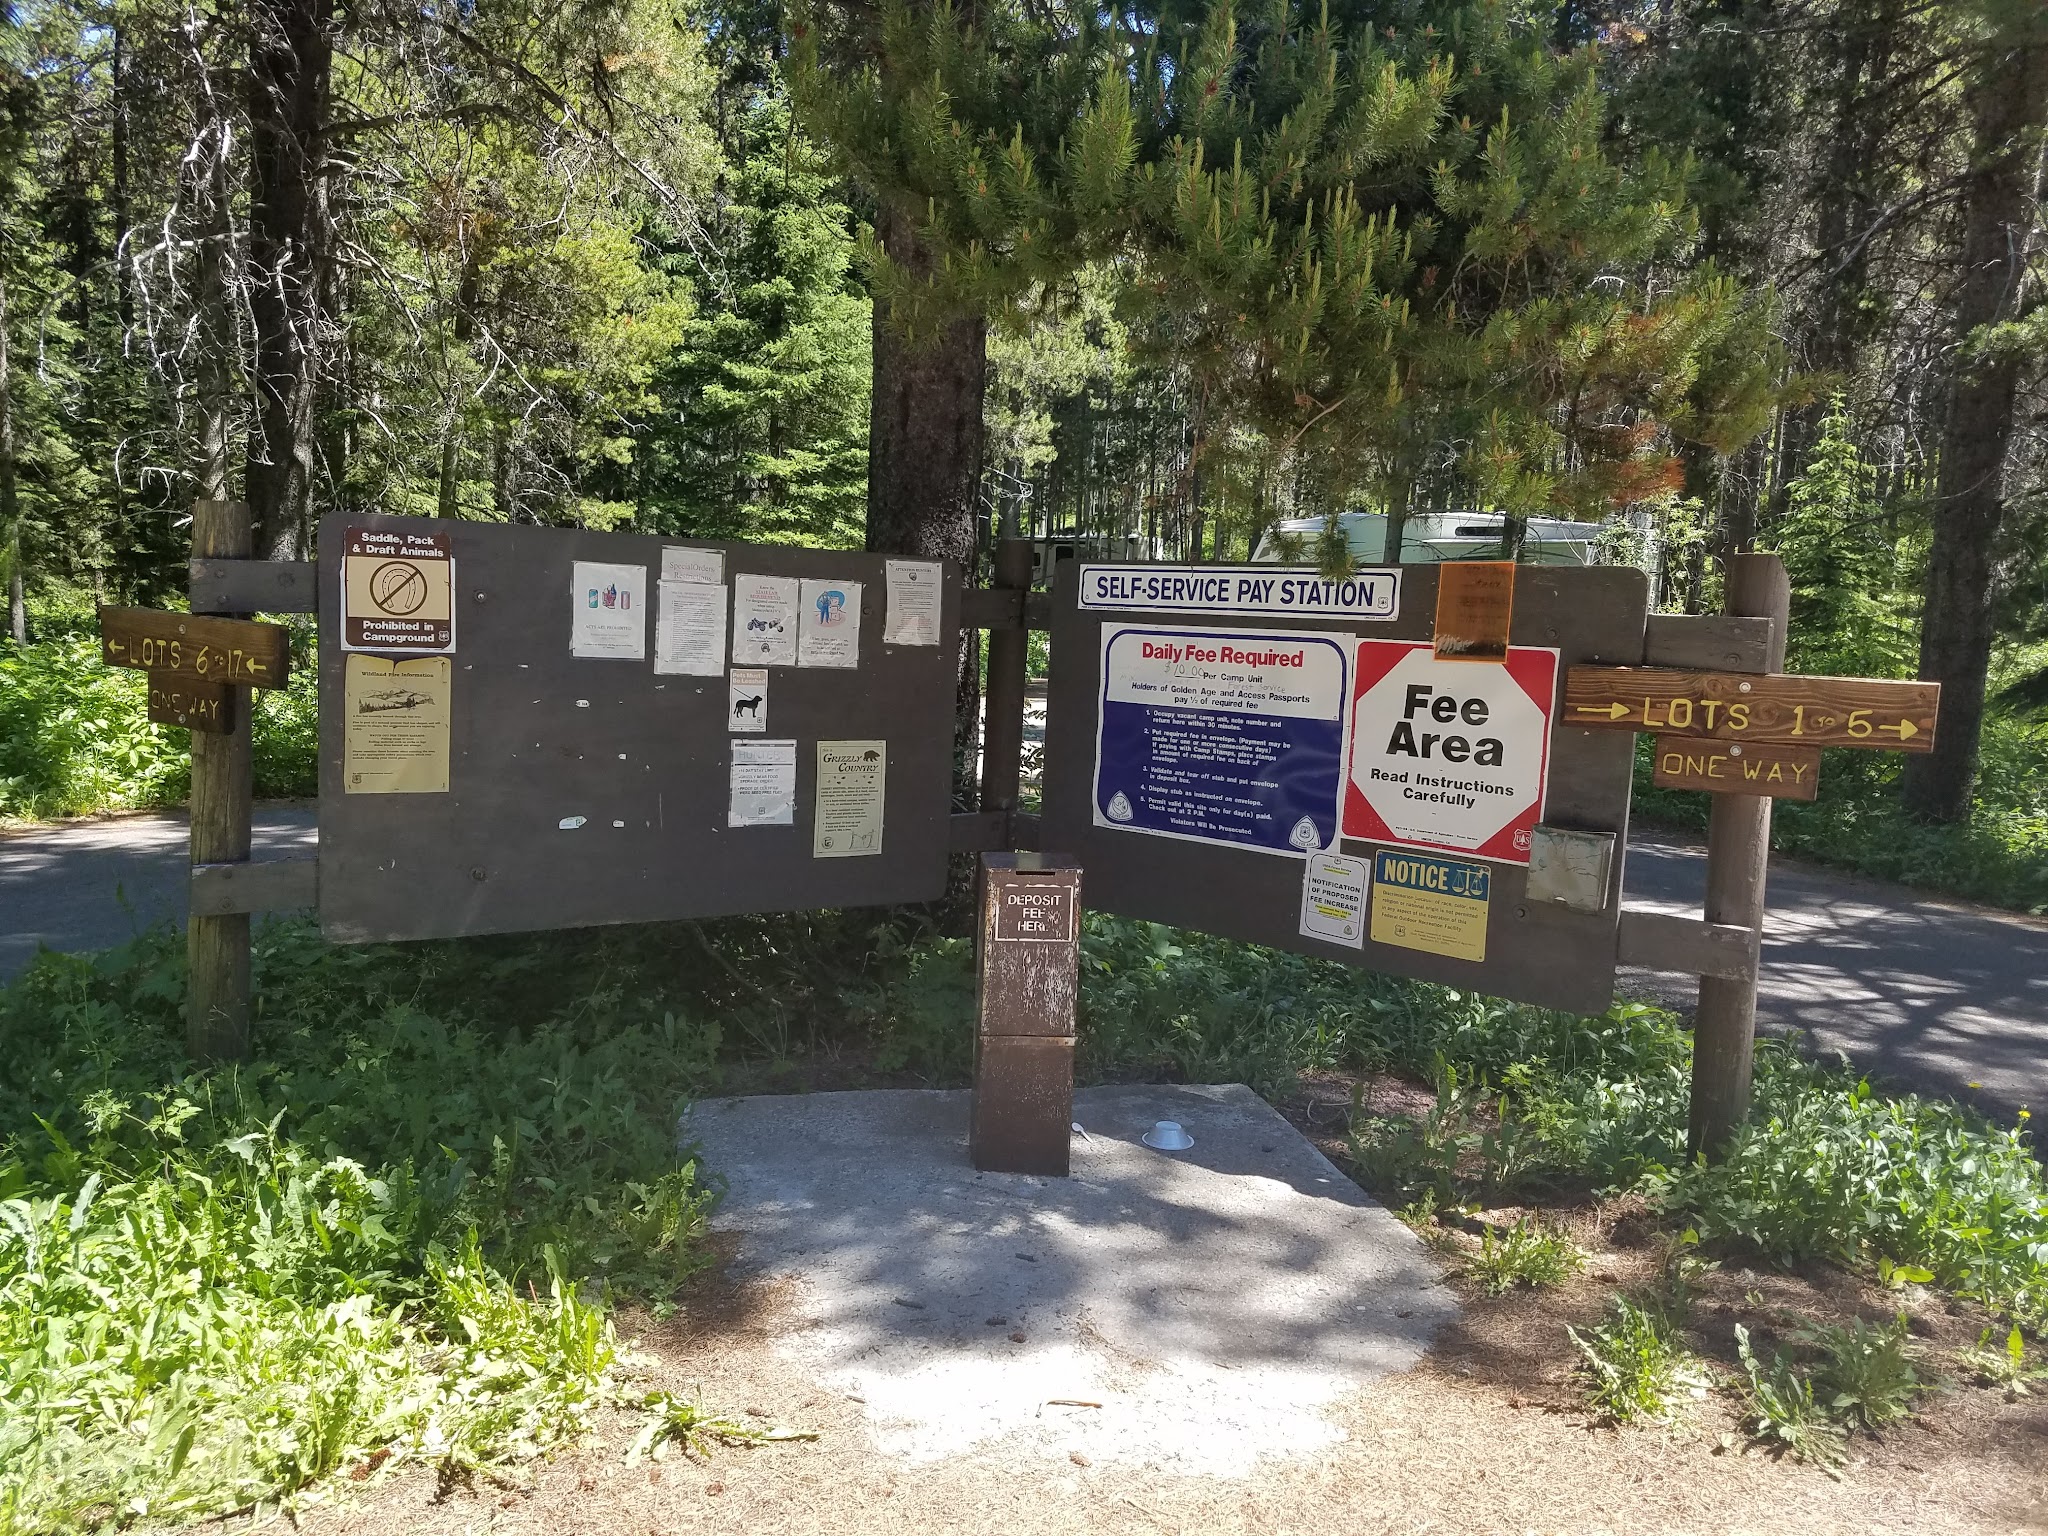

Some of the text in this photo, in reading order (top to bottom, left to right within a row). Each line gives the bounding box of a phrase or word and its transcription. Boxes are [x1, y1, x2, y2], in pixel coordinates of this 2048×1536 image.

[361, 532, 434, 545] Saddle, Pack
[352, 544, 444, 557] & Draft Animals
[1097, 576, 1374, 607] SELF-SERVICE PAY STATION
[363, 621, 434, 631] Prohibited in
[362, 632, 434, 643] Campground
[129, 636, 181, 669] LOTS
[196, 645, 209, 674] 6
[228, 649, 243, 678] 17
[1142, 642, 1304, 668] Daily Fee Required
[1203, 672, 1263, 683] Per Camp Unit
[1132, 682, 1157, 691] Holders
[1171, 686, 1197, 694] Golden
[1201, 688, 1216, 696] Age
[1238, 691, 1266, 700] Access
[1269, 693, 1310, 704] Passports
[151, 690, 219, 721] ONE WAY
[1174, 697, 1188, 705] pay
[1211, 699, 1243, 708] required
[1246, 701, 1258, 709] fee
[1404, 684, 1489, 726] Fee
[1154, 710, 1175, 718] Occupy
[1643, 697, 1750, 732] LOTS
[1791, 705, 1804, 736] 1
[1847, 710, 1873, 738] 5
[1209, 735, 1236, 743] envelope.
[1239, 737, 1266, 746] (Payment
[1219, 743, 1253, 751] consecutive
[1386, 721, 1504, 767] Area
[823, 753, 863, 763] GRIZZLY
[1159, 743, 1177, 751] paying
[1256, 754, 1277, 762] stamps
[1160, 749, 1180, 757] amount
[1191, 753, 1214, 761] required
[838, 762, 879, 772] COUNTRY
[1662, 753, 1808, 785] ONE WAY
[1151, 767, 1172, 775] Validate
[1250, 780, 1279, 788] envelope
[1371, 768, 1514, 797] Read Instructions
[1149, 785, 1168, 794] Display
[1194, 791, 1223, 801] instructed
[1235, 798, 1263, 806] envelope.
[1403, 787, 1475, 809] Carefully
[1148, 797, 1166, 805] Permit
[1233, 810, 1253, 818] day(s)
[1170, 817, 1195, 826] Violators
[1219, 825, 1252, 835] Prosecuted
[1384, 858, 1450, 891] NOTICE
[1312, 877, 1361, 893] NOTIFICATION
[1007, 894, 1062, 906] DEPOSIT
[1310, 896, 1322, 904] FEE
[1324, 899, 1358, 911] INCREASE
[1322, 889, 1359, 902] PROPOSED
[1023, 908, 1046, 919] FEE
